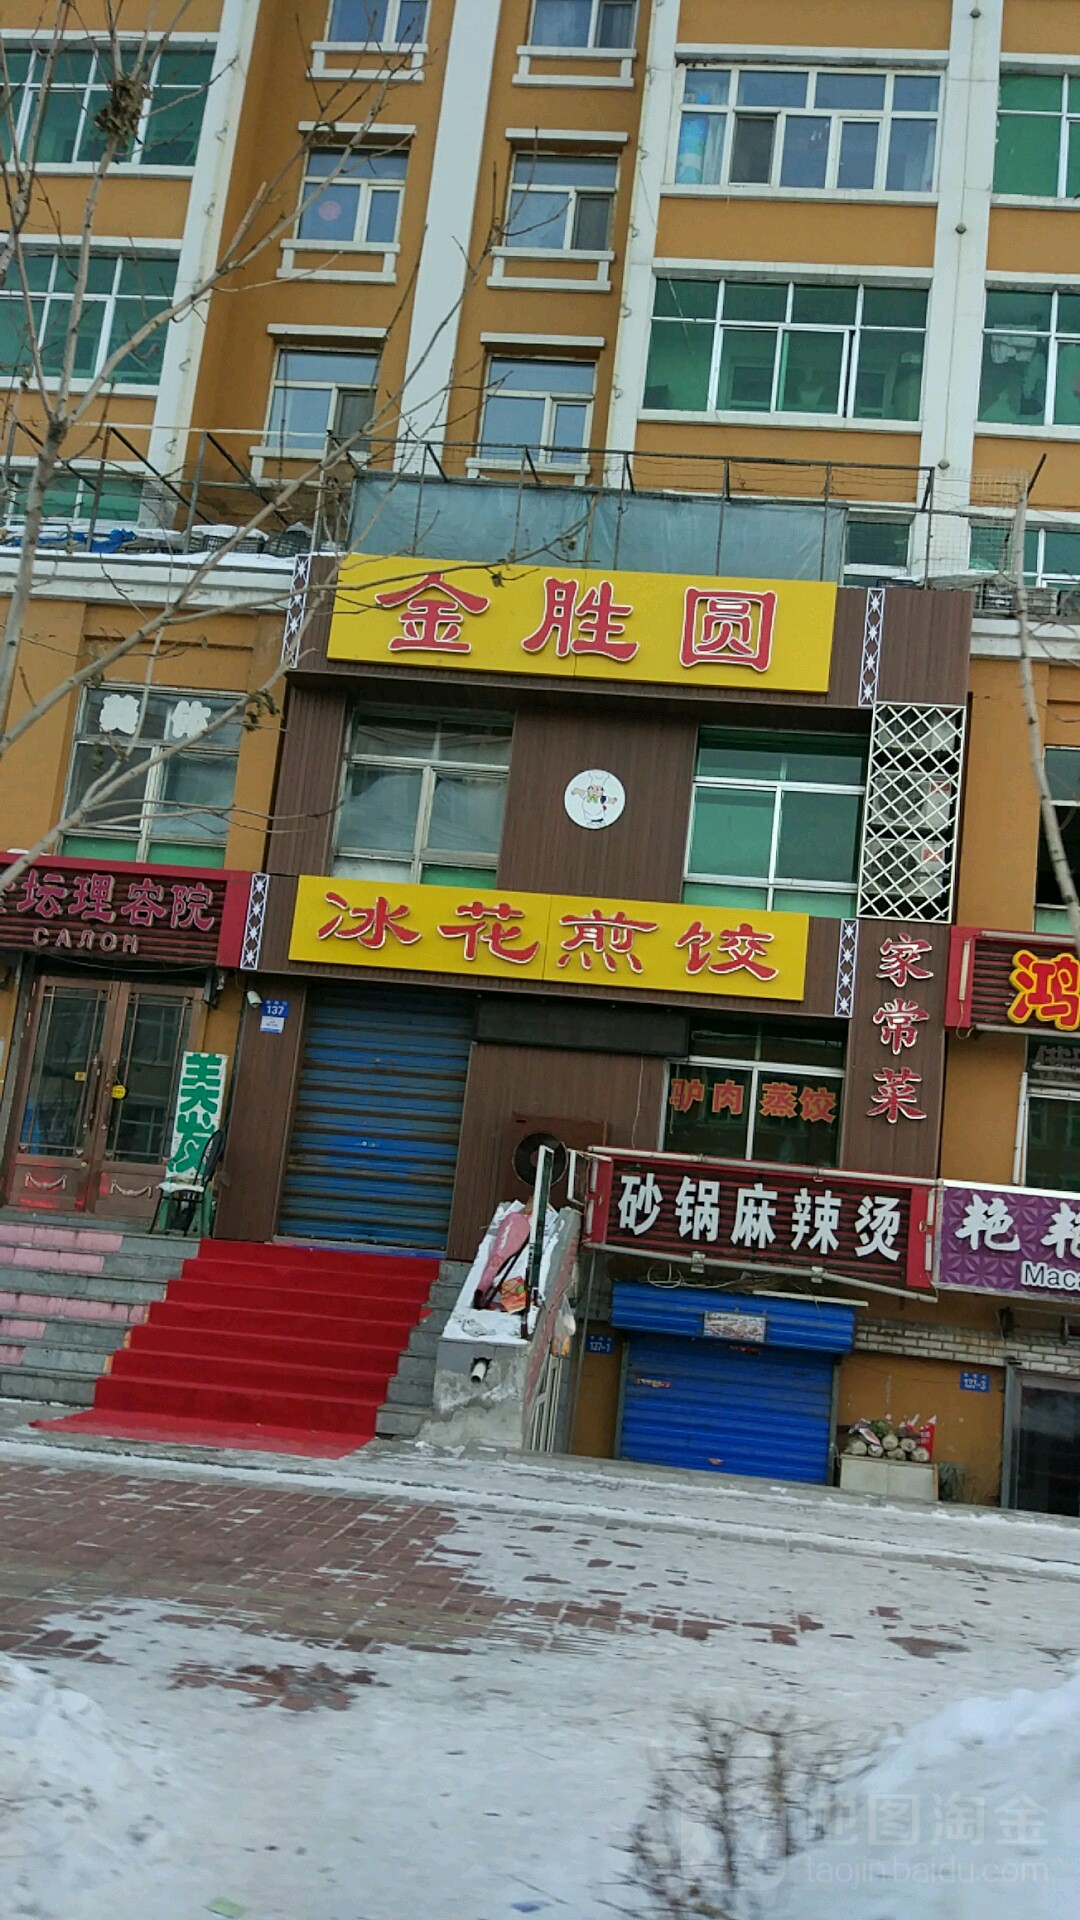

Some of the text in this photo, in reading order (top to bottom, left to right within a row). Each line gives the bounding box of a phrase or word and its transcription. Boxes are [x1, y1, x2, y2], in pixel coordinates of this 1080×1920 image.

[375, 573, 777, 672] 金胜圆
[0, 869, 215, 932] 坛理容院
[317, 891, 779, 981] 冰花煎饺
[266, 1005, 285, 1016] 137
[867, 933, 934, 1123] 家常菜
[618, 1172, 901, 1262] 砂锅麻辣烫
[1023, 1262, 1080, 1289] Mac
